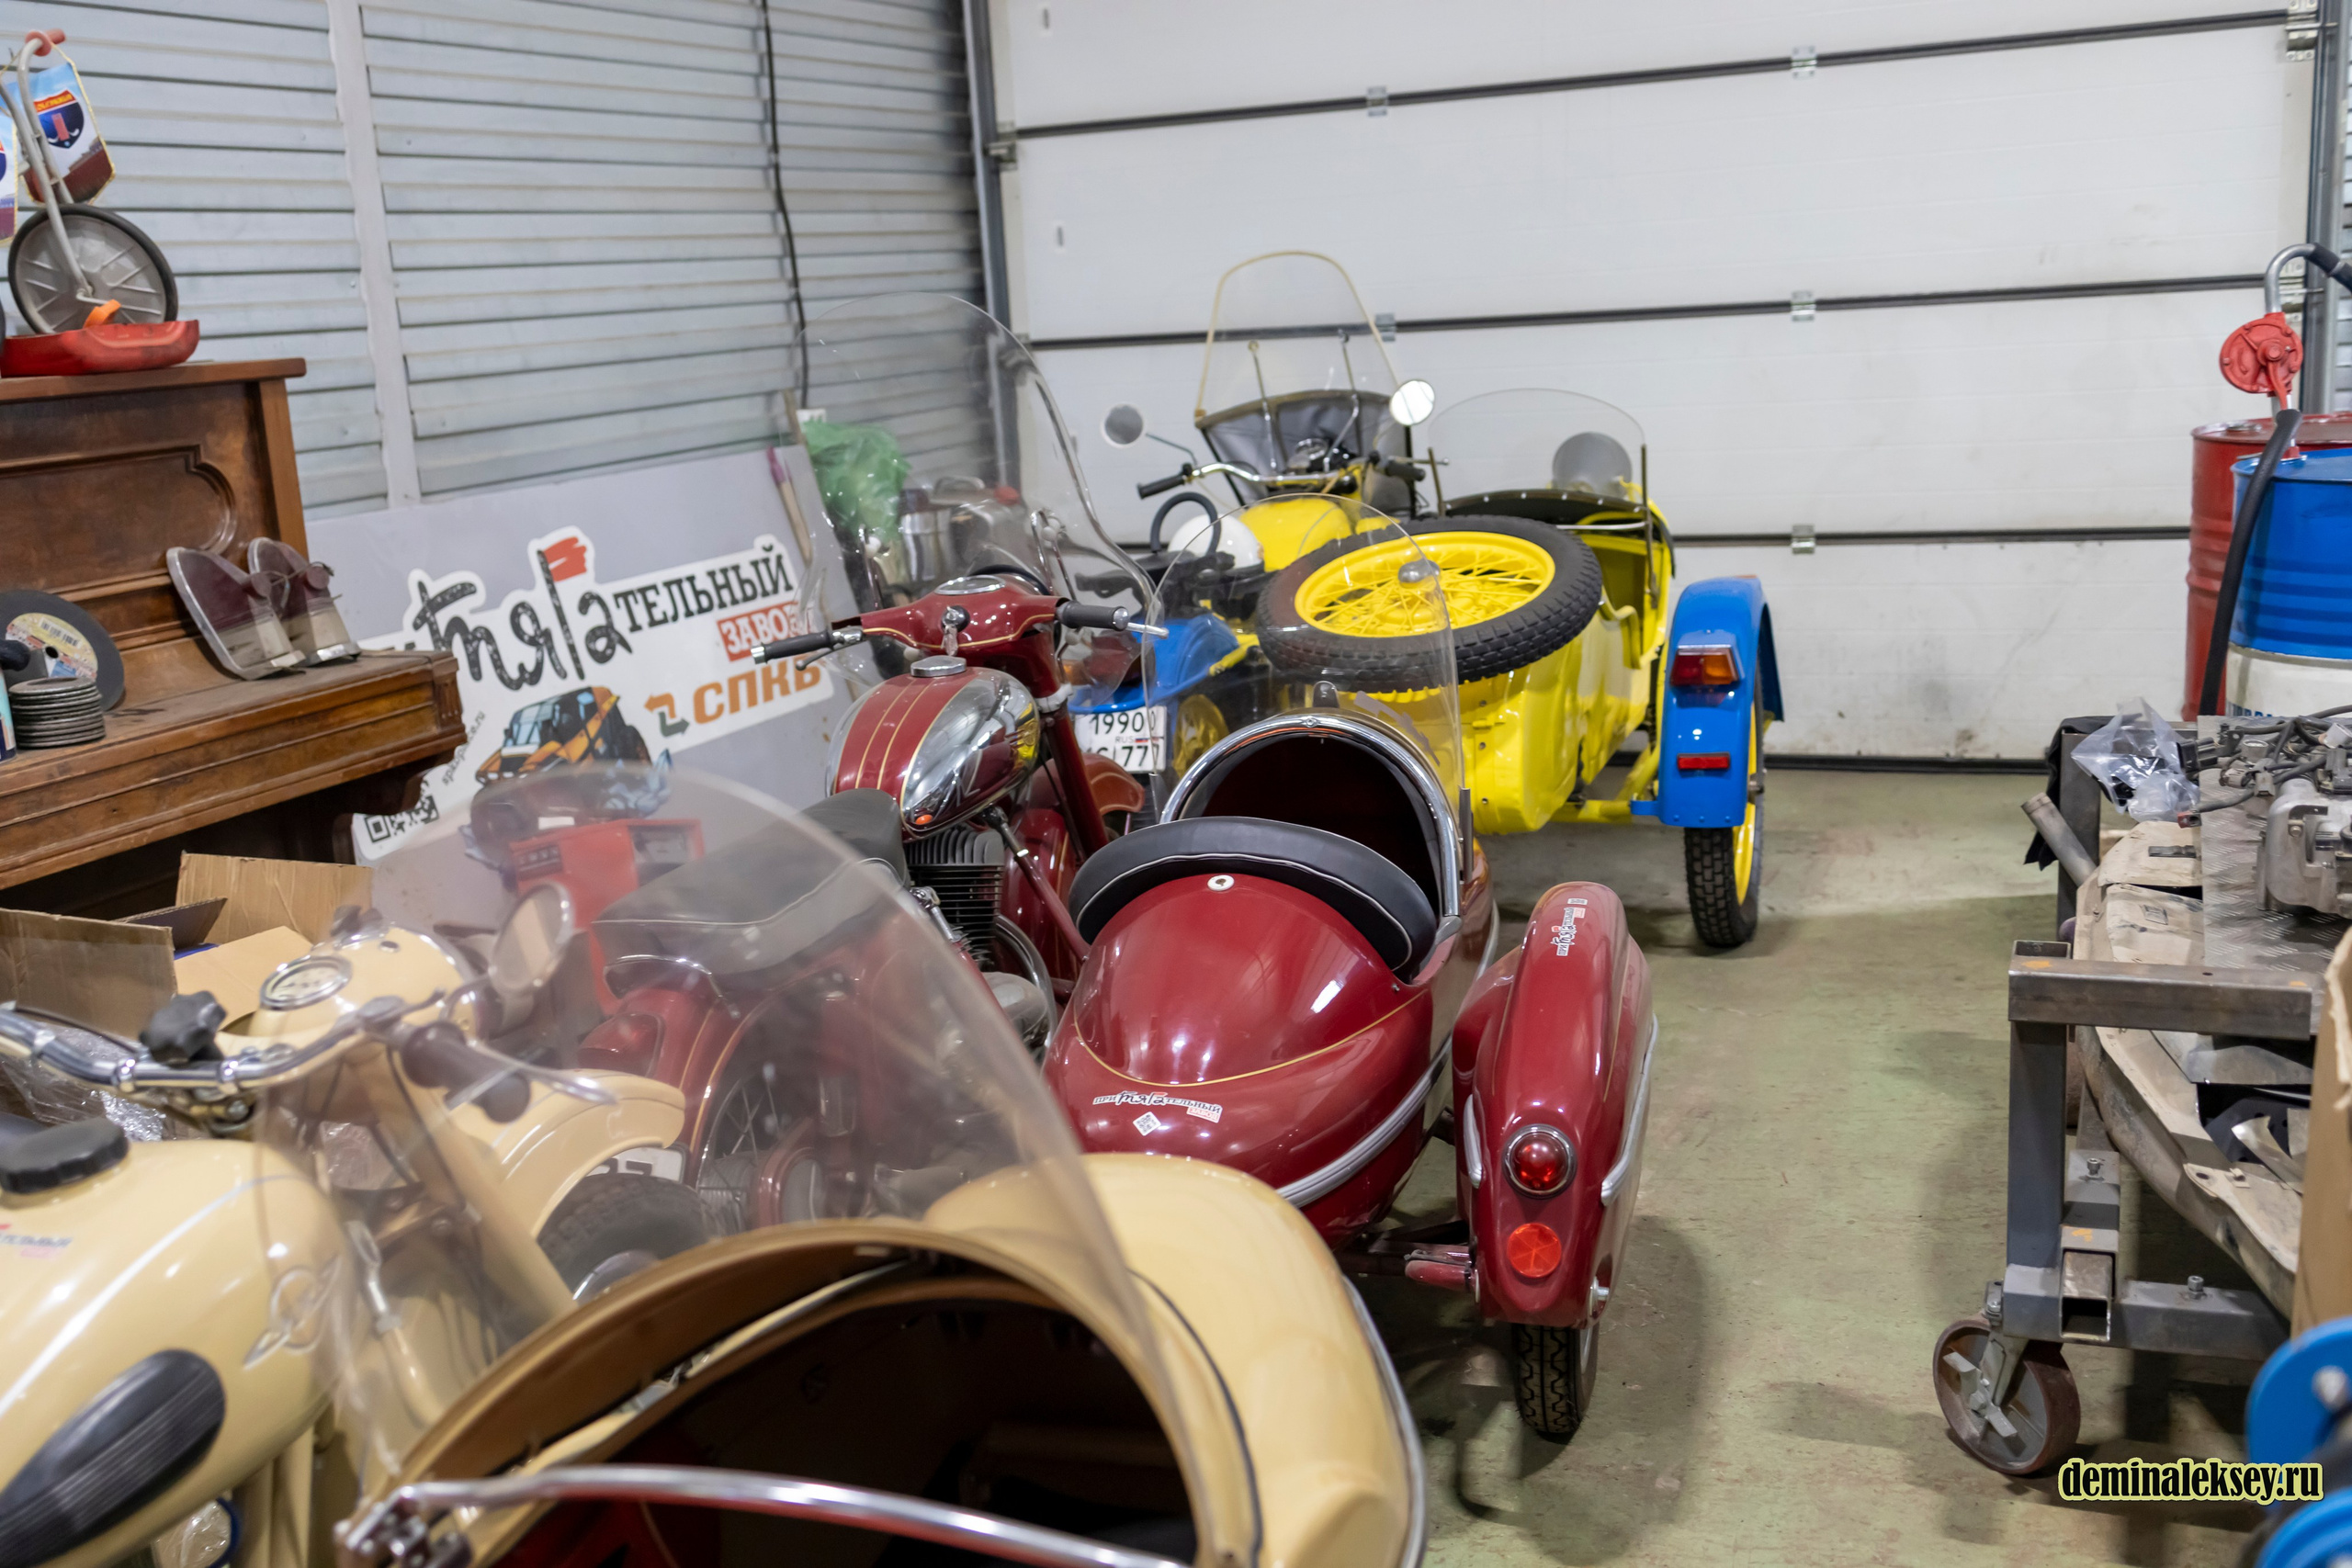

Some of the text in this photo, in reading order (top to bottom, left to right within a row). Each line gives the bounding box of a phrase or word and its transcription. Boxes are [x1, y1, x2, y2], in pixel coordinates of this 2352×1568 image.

[693, 653, 822, 725] СПКБ
[1090, 712, 1145, 735] 1990
[1115, 735, 1135, 744] RUS
